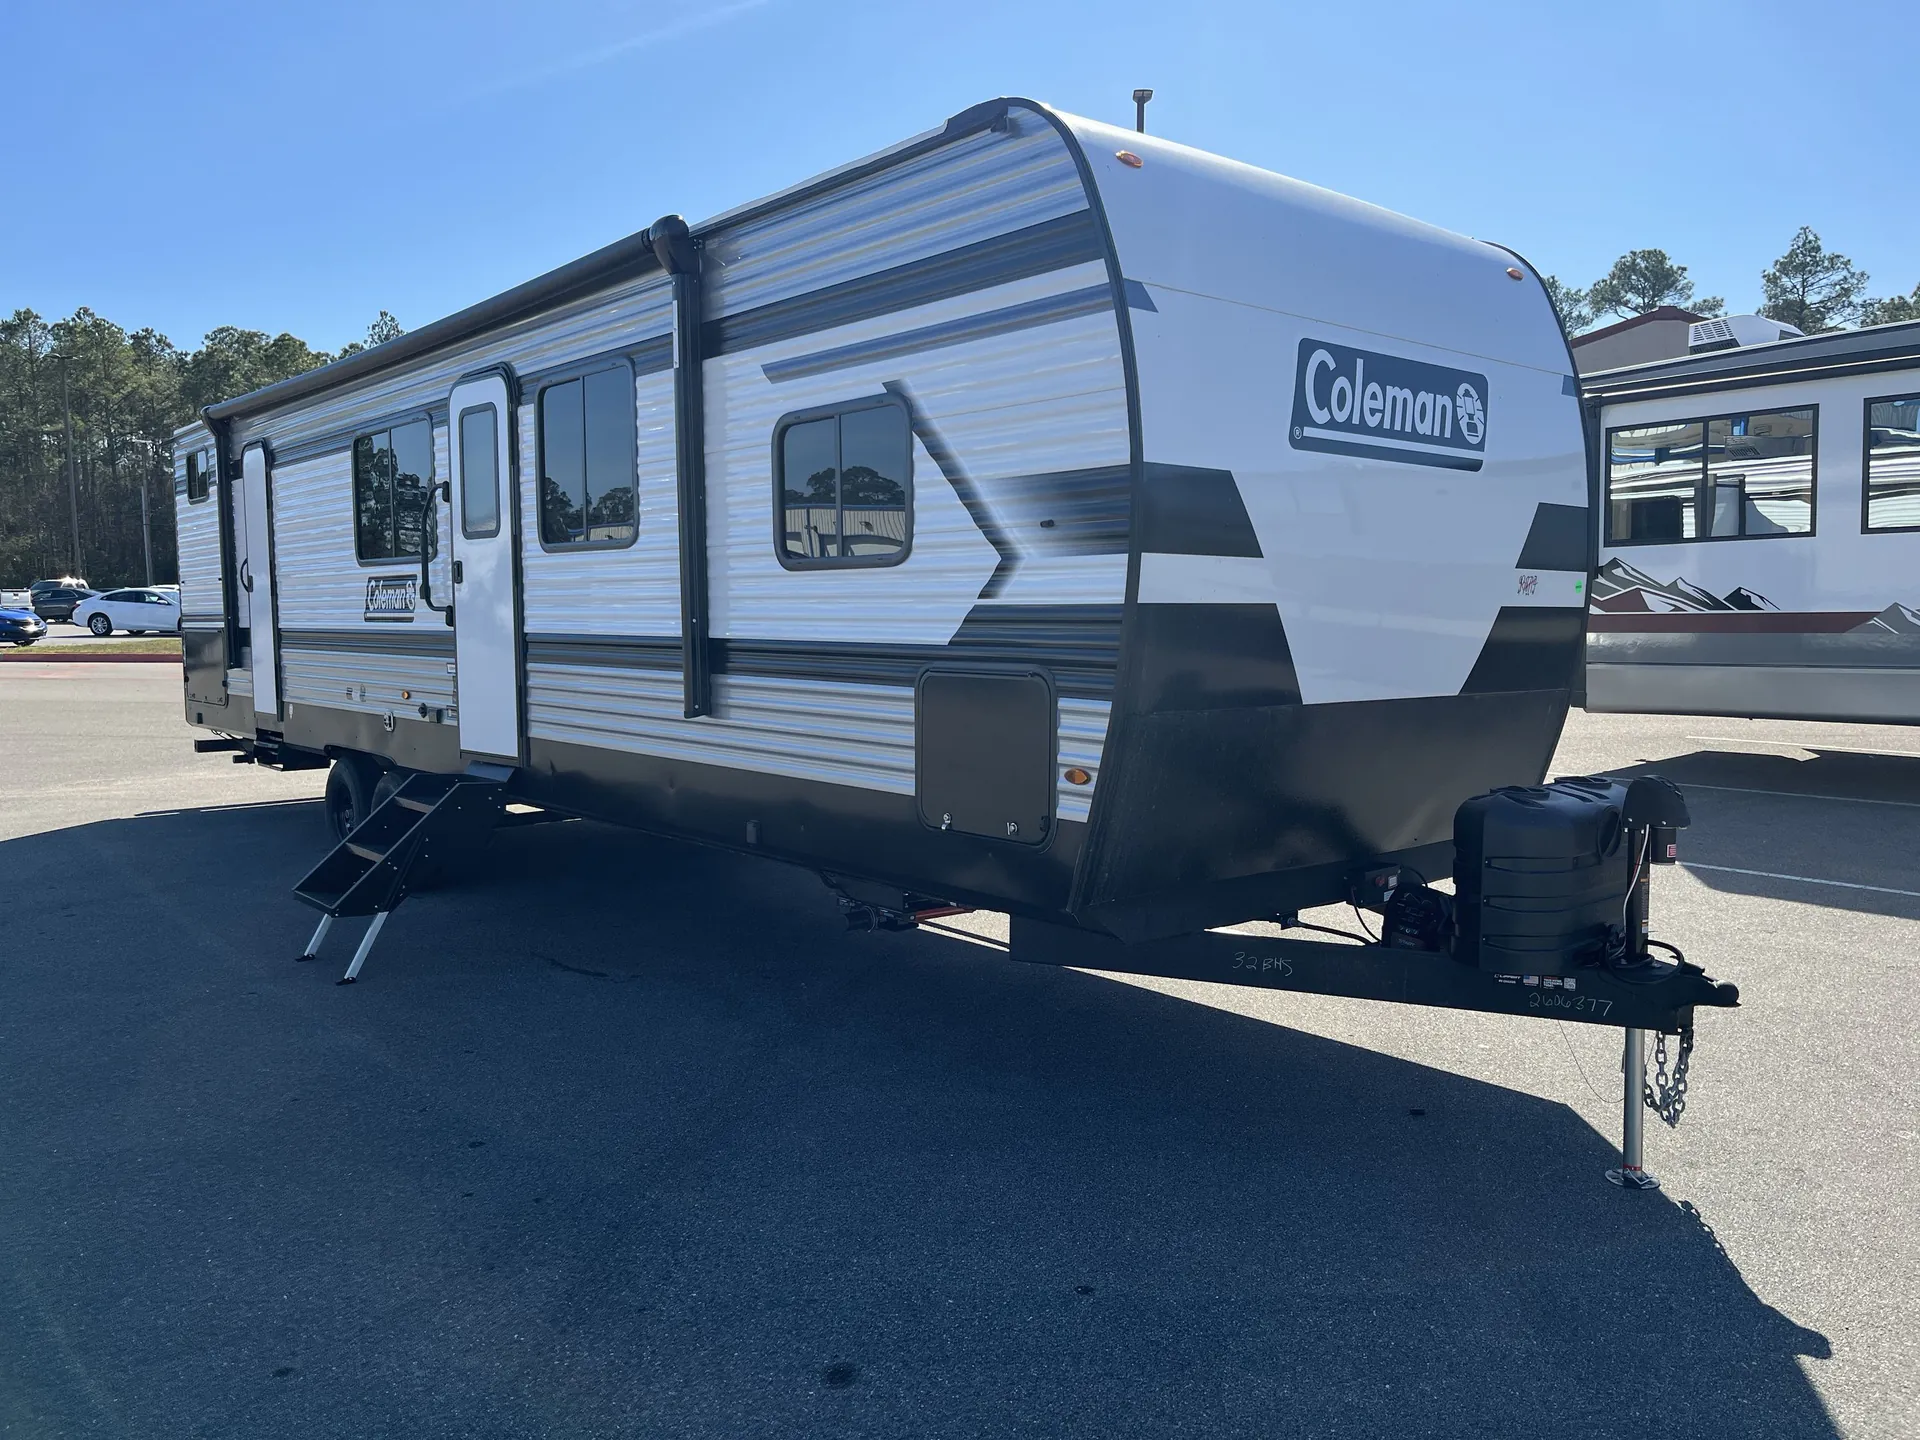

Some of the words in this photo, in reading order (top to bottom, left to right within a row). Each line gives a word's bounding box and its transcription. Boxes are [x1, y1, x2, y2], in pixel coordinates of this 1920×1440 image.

[1305, 348, 1453, 438] Coleman
[368, 579, 406, 611] Coleman
[1528, 992, 1613, 1017] 2606377
